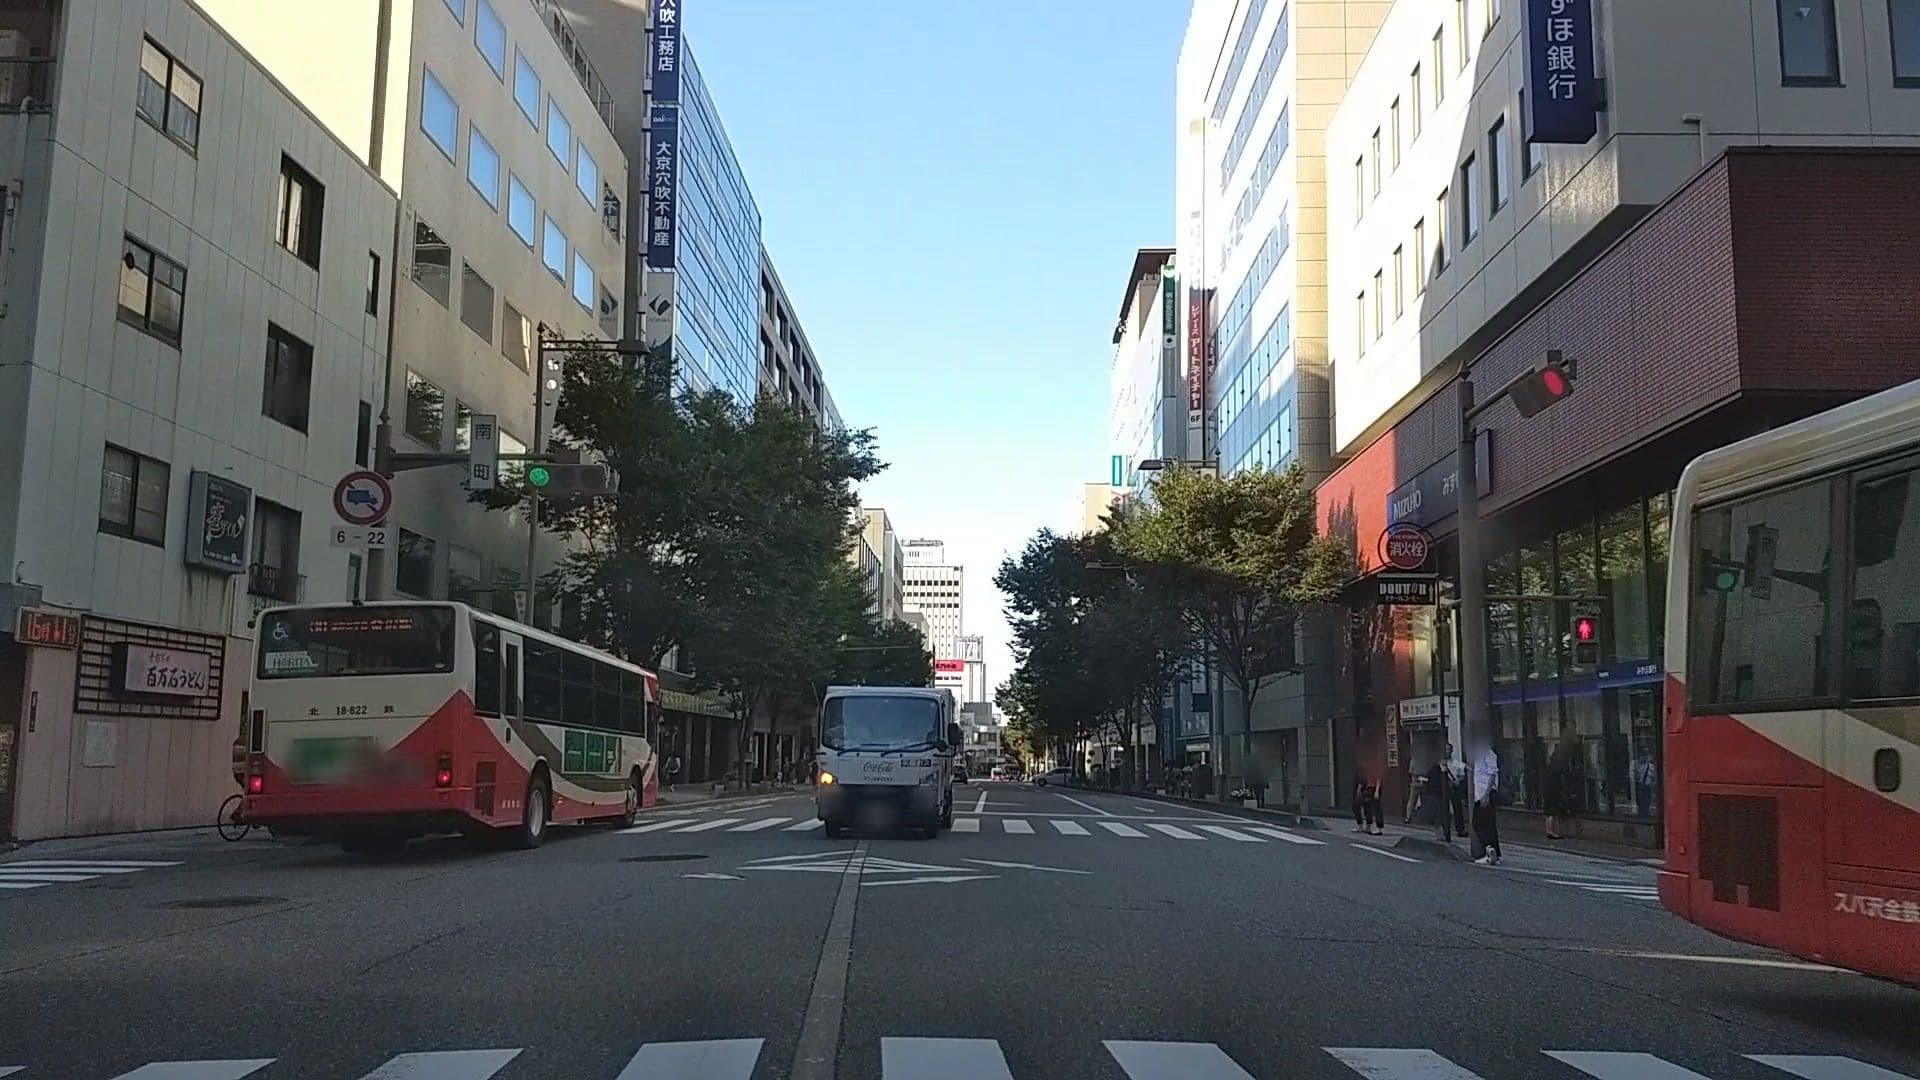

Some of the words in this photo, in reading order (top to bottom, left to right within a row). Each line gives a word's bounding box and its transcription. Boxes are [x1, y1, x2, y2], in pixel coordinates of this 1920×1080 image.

[653, 141, 673, 247] 大京穴吹不動産
[1190, 415, 1201, 423] 6F
[473, 423, 492, 481] 南町
[1392, 489, 1422, 521] MIZUHO
[1389, 540, 1424, 557] 消火栓
[1379, 582, 1427, 595] DOUTOR
[147, 666, 206, 690] 百万石うどん
[308, 707, 319, 716] 北
